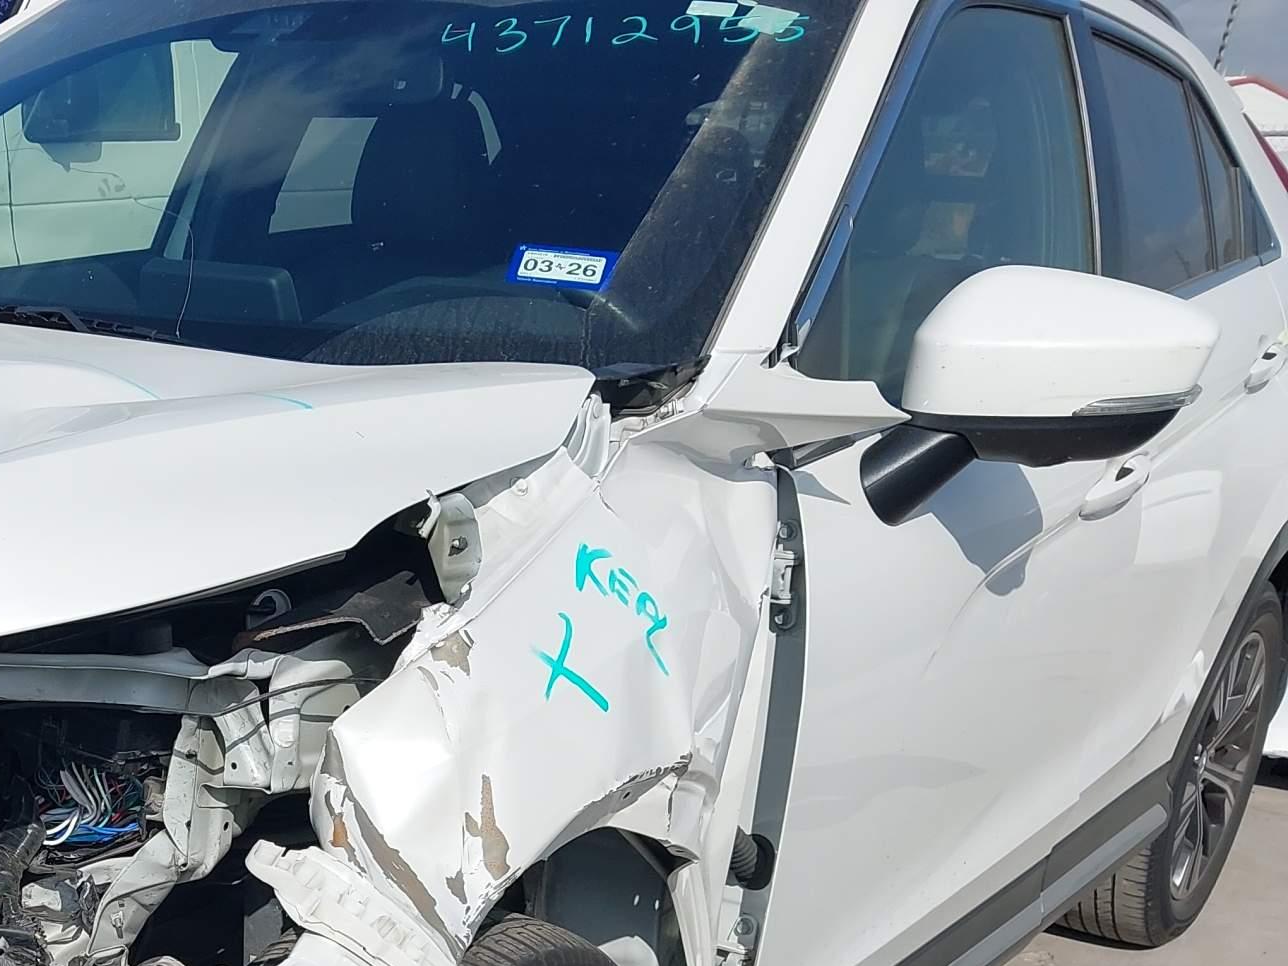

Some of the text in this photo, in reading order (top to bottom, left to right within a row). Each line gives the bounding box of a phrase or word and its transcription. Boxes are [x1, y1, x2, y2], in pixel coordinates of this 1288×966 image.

[441, 14, 810, 53] 43712955
[523, 258, 598, 278] 03 26
